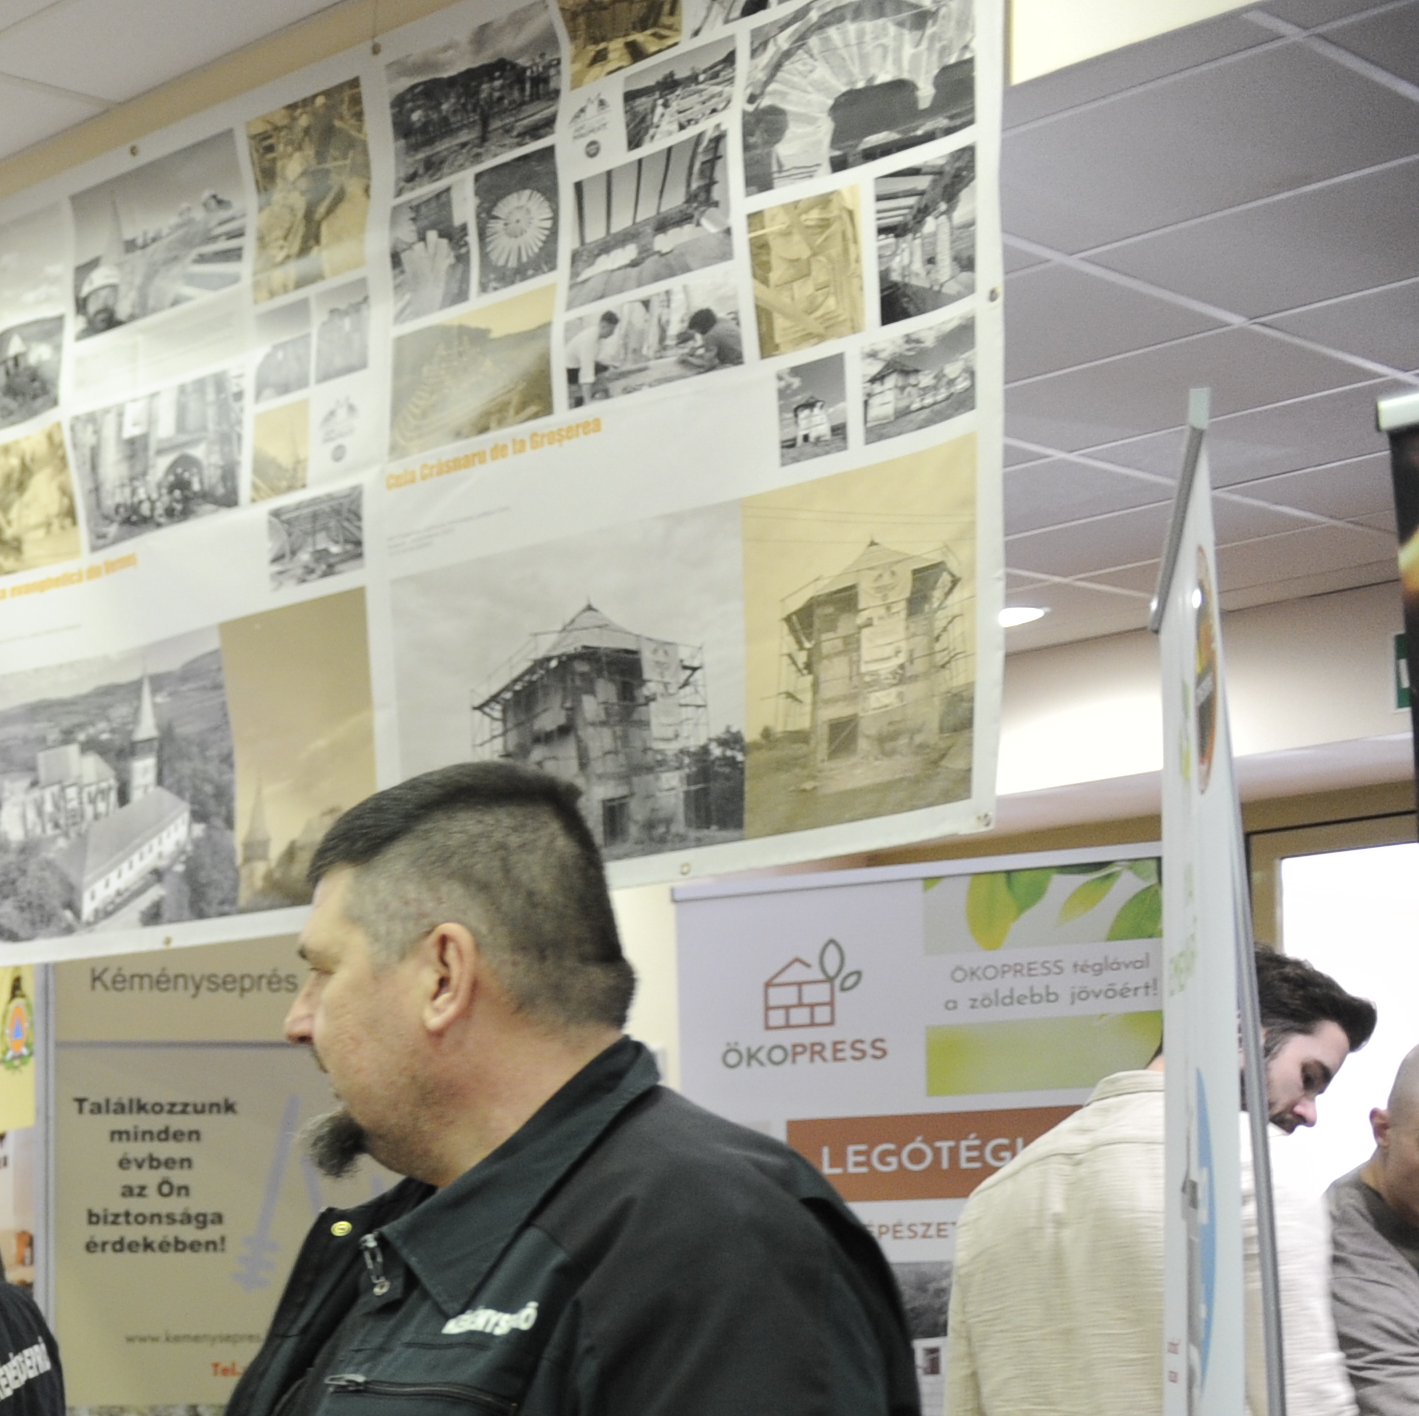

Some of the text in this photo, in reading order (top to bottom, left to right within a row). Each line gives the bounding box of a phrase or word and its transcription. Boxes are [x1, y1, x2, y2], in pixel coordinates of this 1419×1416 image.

[950, 952, 1151, 984] ÖKOPRESS téglával
[90, 966, 300, 998] Kéményseprés
[944, 977, 1160, 1012] a zöldebb jövőért!
[721, 1037, 889, 1070] ÖKOPRESS
[73, 1096, 238, 1117] Találkozzunk
[109, 1126, 202, 1143] minden
[117, 1151, 194, 1172] évben
[121, 1177, 191, 1198] az Ön
[86, 1206, 224, 1230] biztonsága
[84, 1234, 227, 1255] érdekében!
